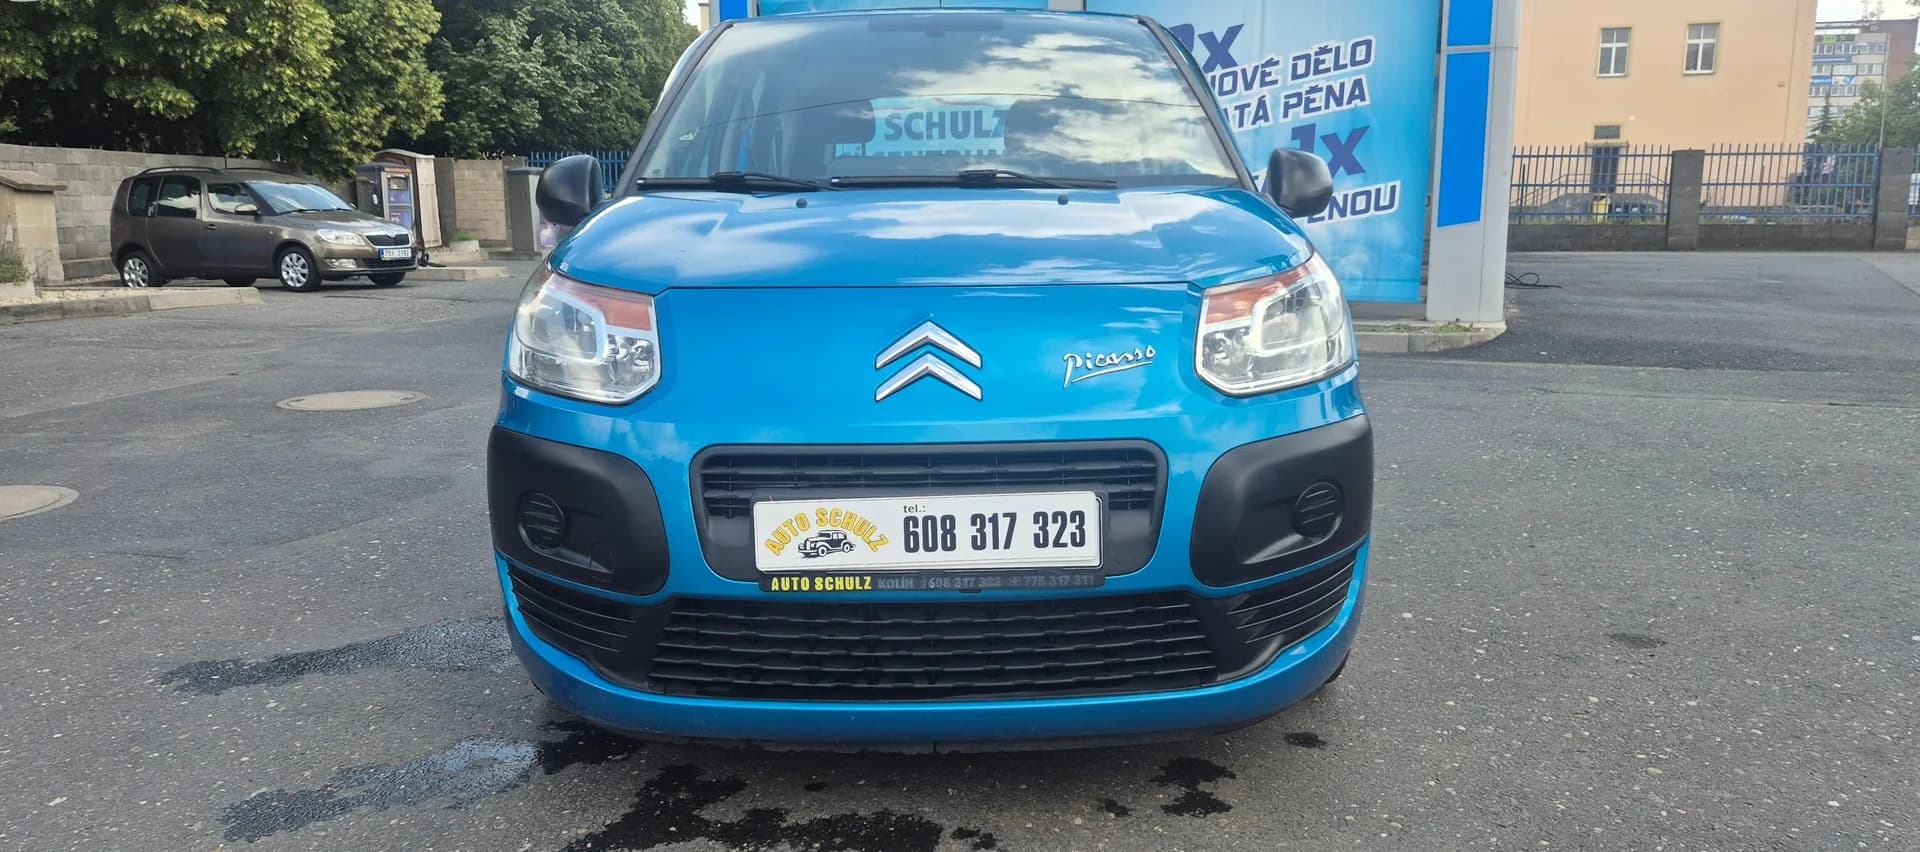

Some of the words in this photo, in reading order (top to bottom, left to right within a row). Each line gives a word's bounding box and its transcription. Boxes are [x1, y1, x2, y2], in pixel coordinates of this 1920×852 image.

[1290, 38, 1373, 82] DĚLO
[1282, 78, 1367, 119] PĚNA
[1063, 345, 1156, 388] Picasso
[903, 503, 926, 514] tel.:
[764, 512, 810, 556] AUTO
[815, 507, 889, 552] SCHULZ
[904, 514, 956, 553] 608
[970, 511, 1018, 551] 317
[1032, 509, 1087, 549] 323
[771, 576, 810, 591] AUTO
[814, 576, 872, 591] SCHULZ
[928, 577, 951, 589] 608
